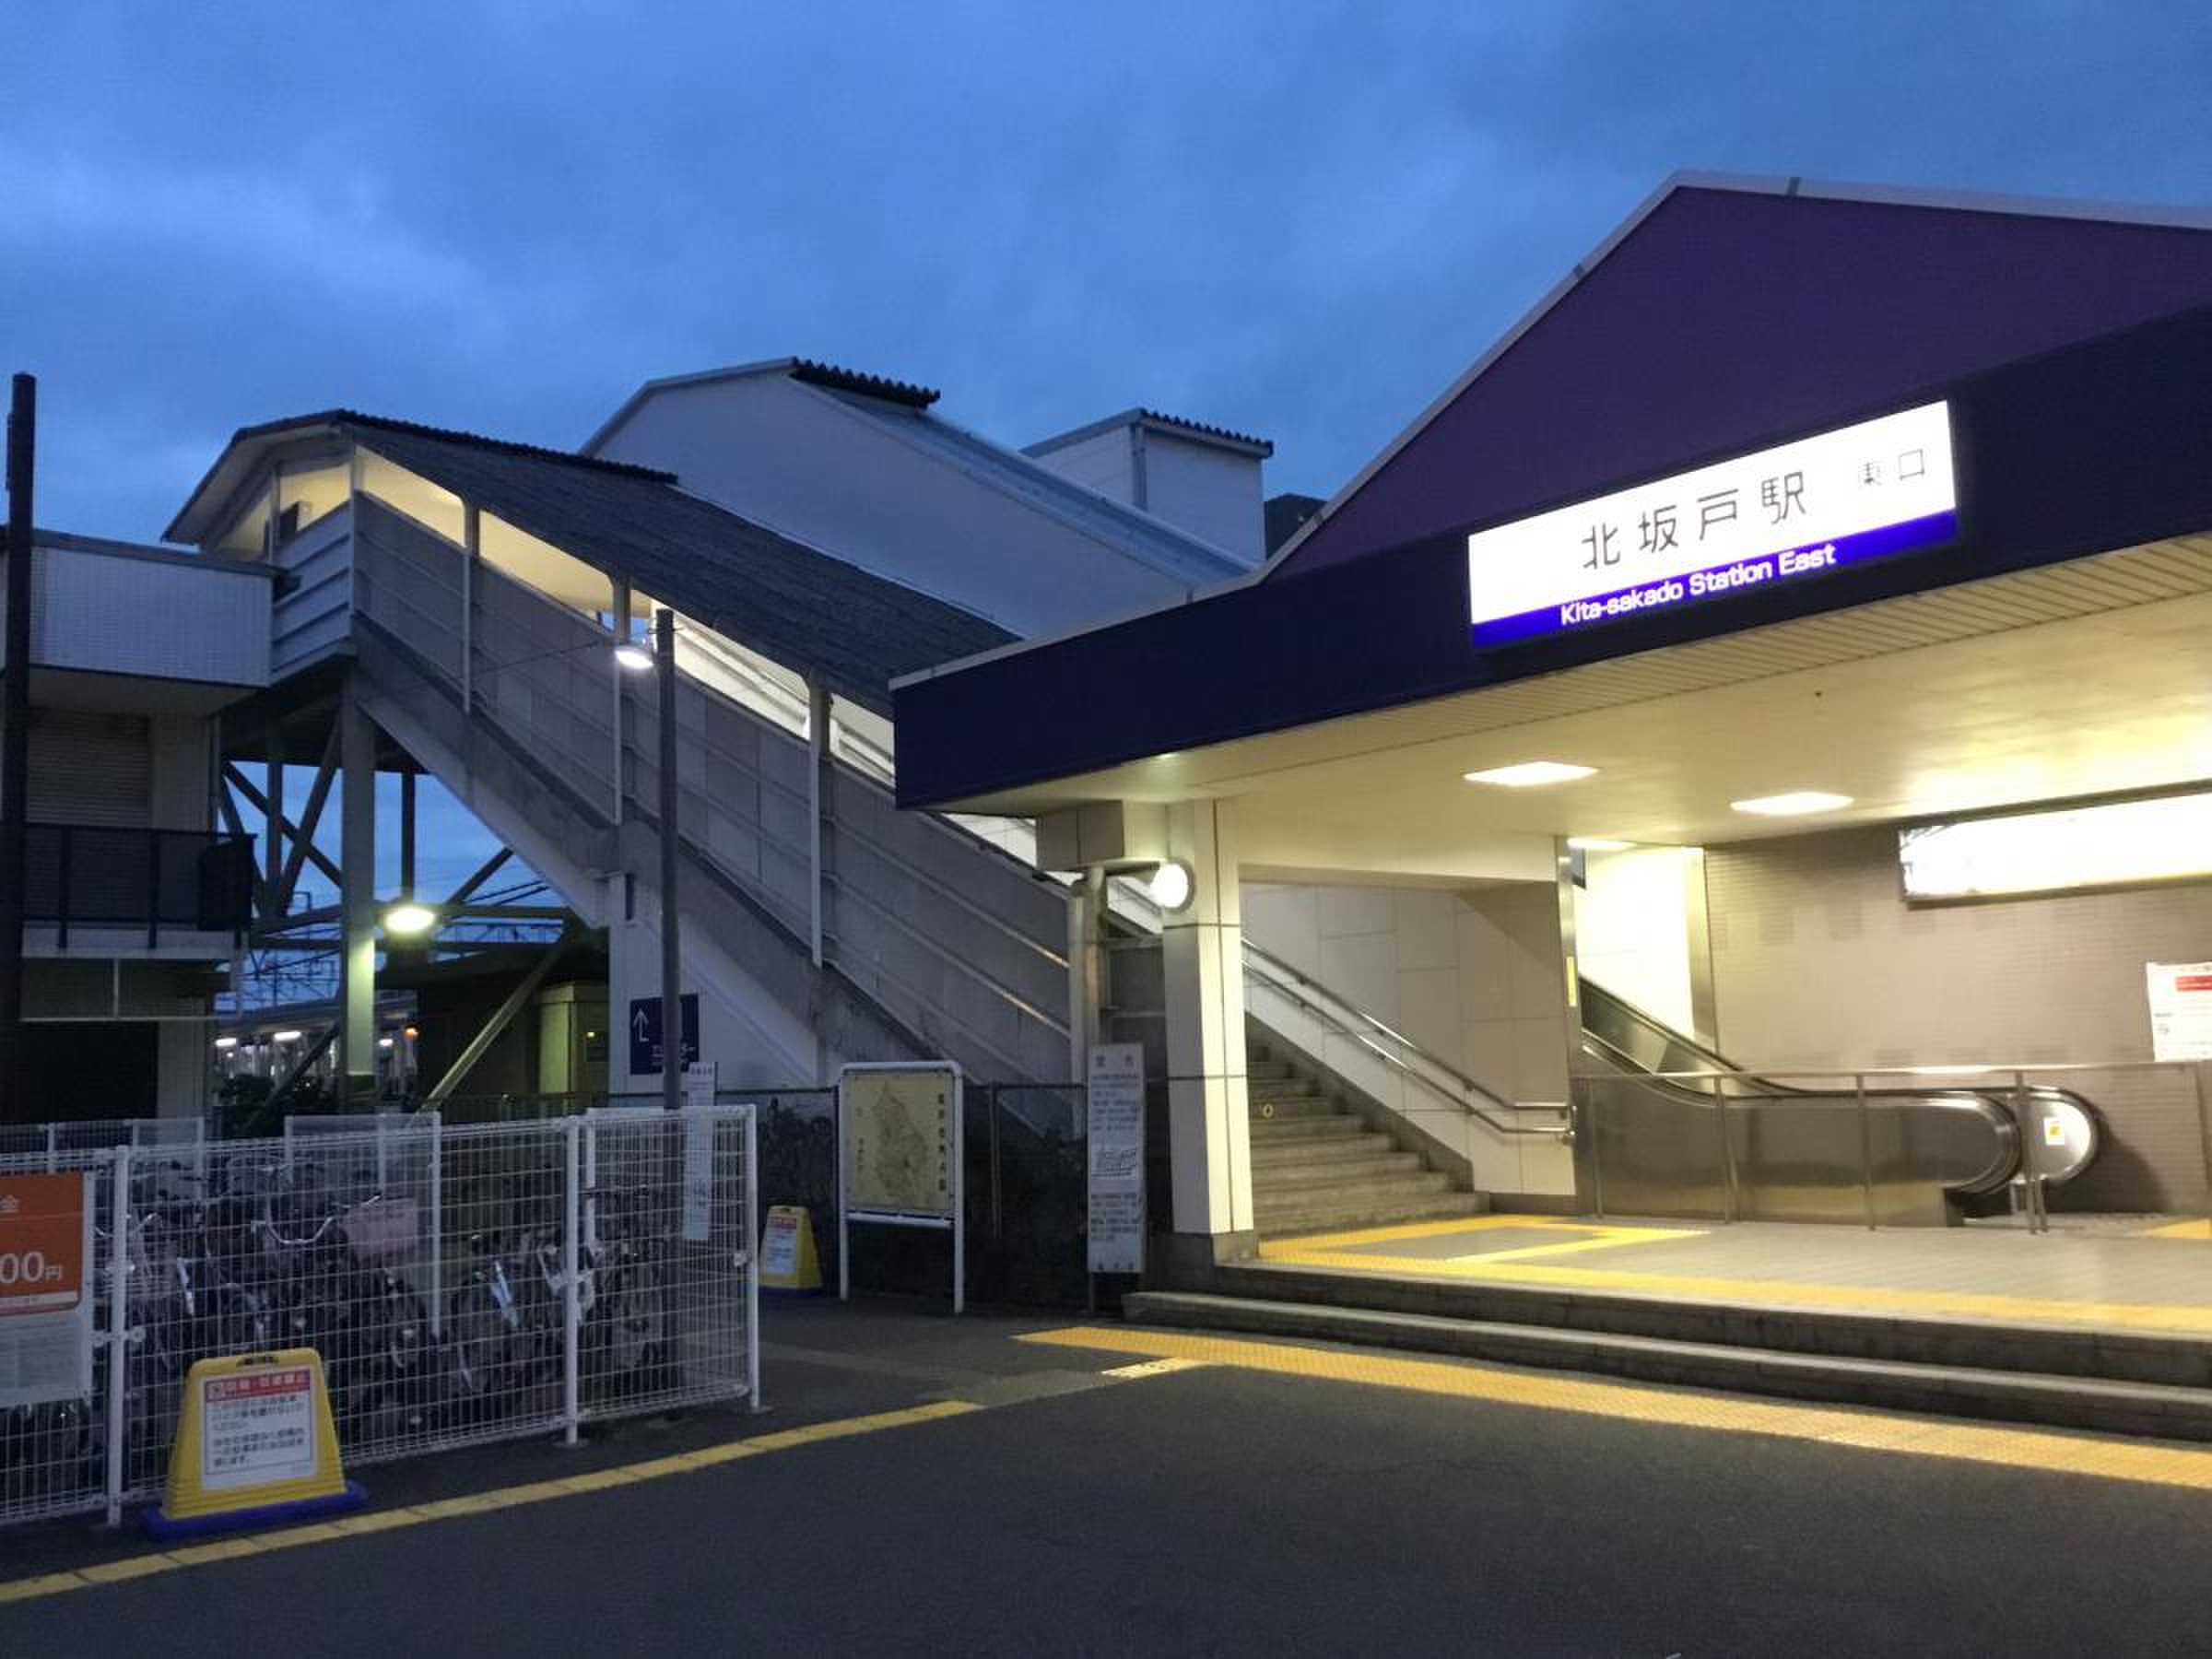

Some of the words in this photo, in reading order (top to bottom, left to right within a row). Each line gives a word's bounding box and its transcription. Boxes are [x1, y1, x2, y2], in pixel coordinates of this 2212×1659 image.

[1581, 470, 1807, 570] 北坂戸駅
[1559, 582, 1684, 626] Kita-sakado
[1688, 561, 1773, 596] Station
[1777, 544, 1837, 576] East
